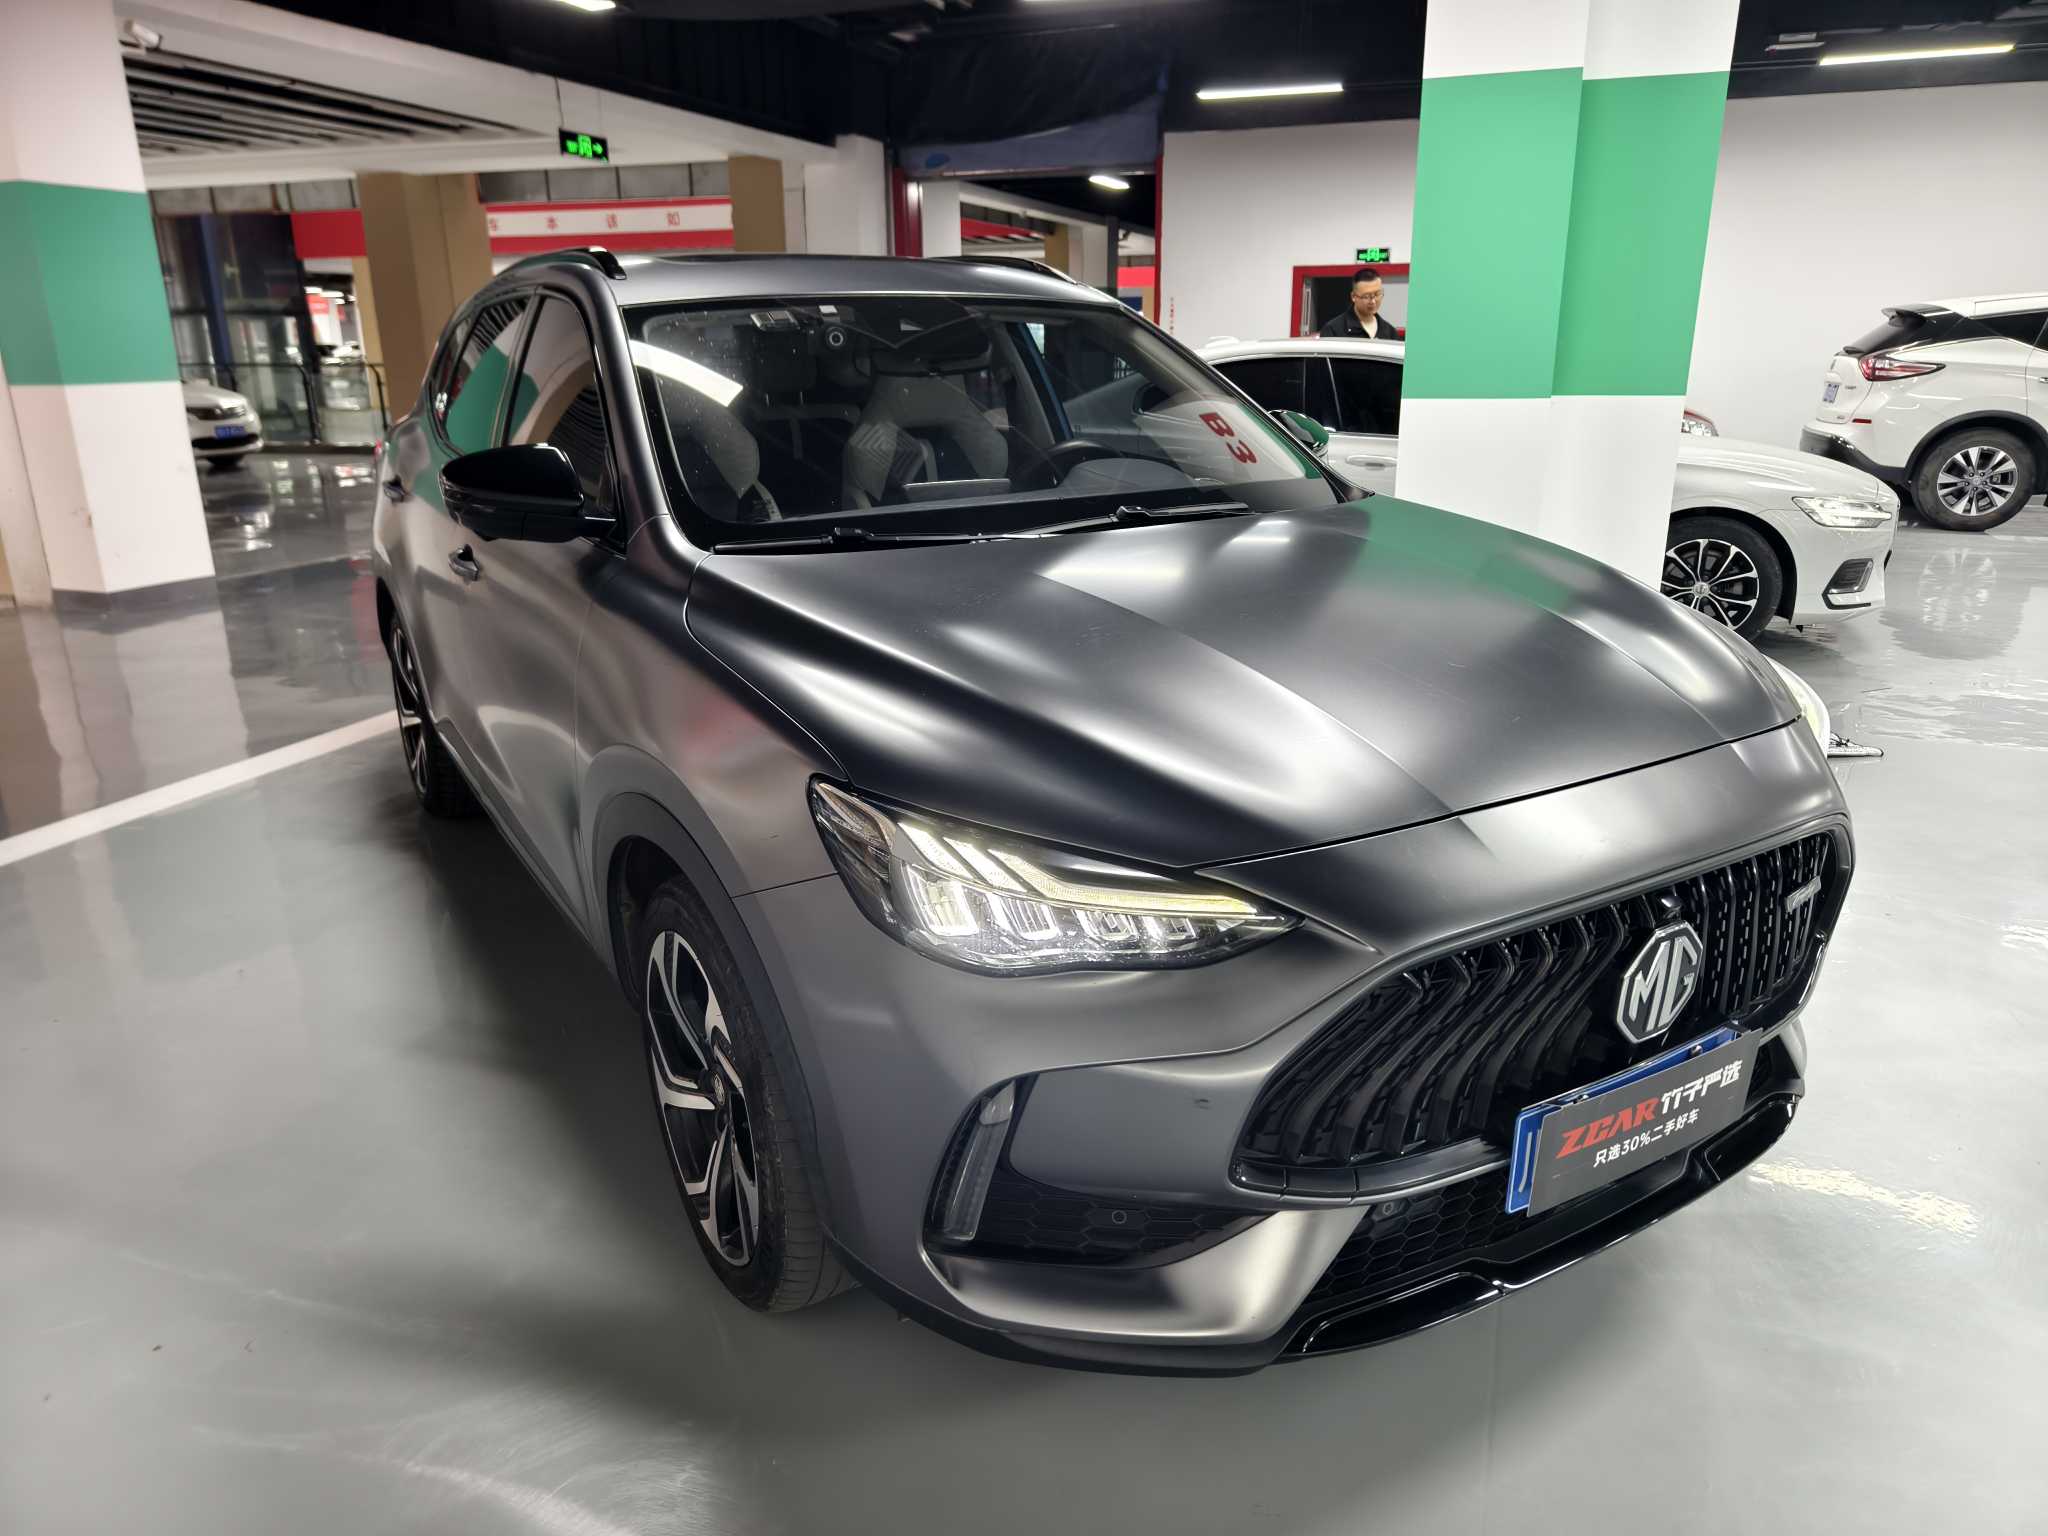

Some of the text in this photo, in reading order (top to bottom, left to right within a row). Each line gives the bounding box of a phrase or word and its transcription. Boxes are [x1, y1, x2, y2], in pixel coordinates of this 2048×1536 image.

[1629, 935, 1698, 1033] MG
[1556, 1060, 1743, 1159] ZCAR 竹子严选
[1593, 1108, 1700, 1168] 只选30%二手好车
